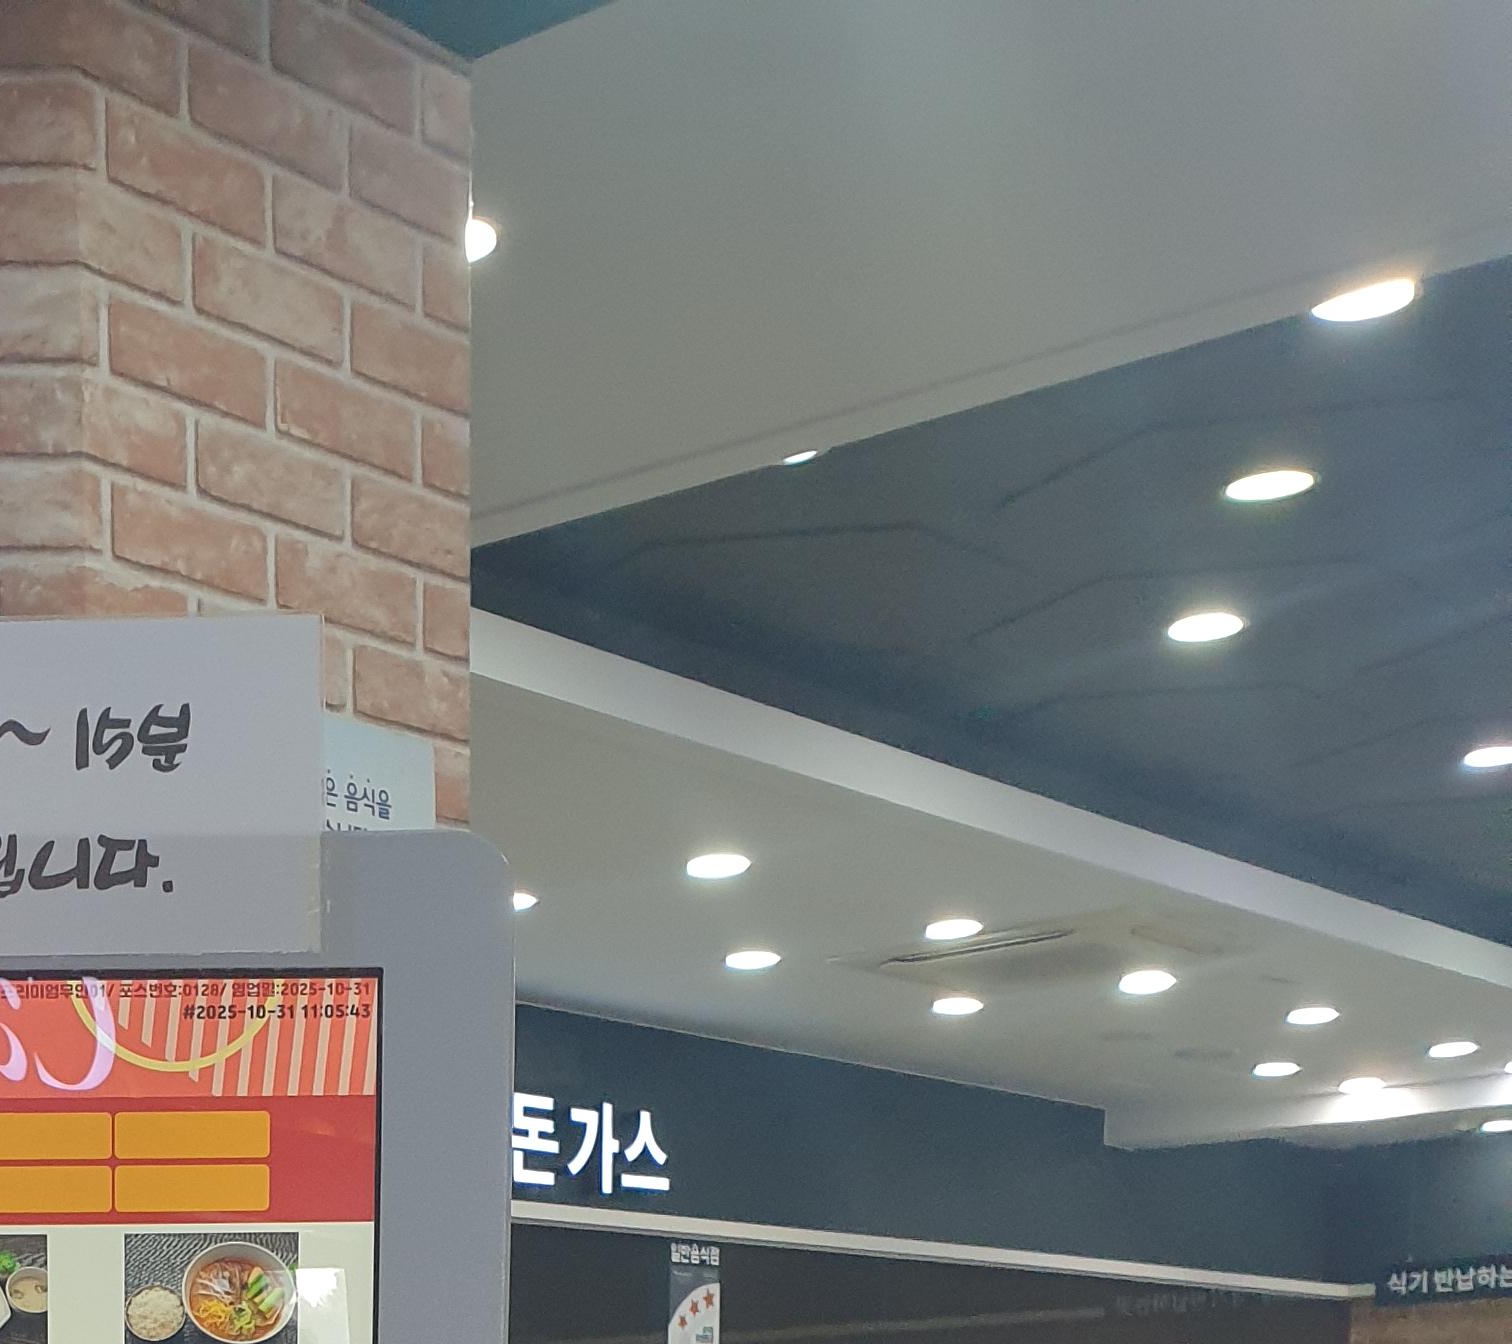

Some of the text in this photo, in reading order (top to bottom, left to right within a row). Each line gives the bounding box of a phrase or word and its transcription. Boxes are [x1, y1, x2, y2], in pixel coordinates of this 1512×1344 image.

[344, 774, 393, 821] 음식을
[182, 1002, 371, 1020] #2025-10-31 11:05:43
[511, 1091, 671, 1196] 돈가스
[1387, 1269, 1429, 1296] 식기
